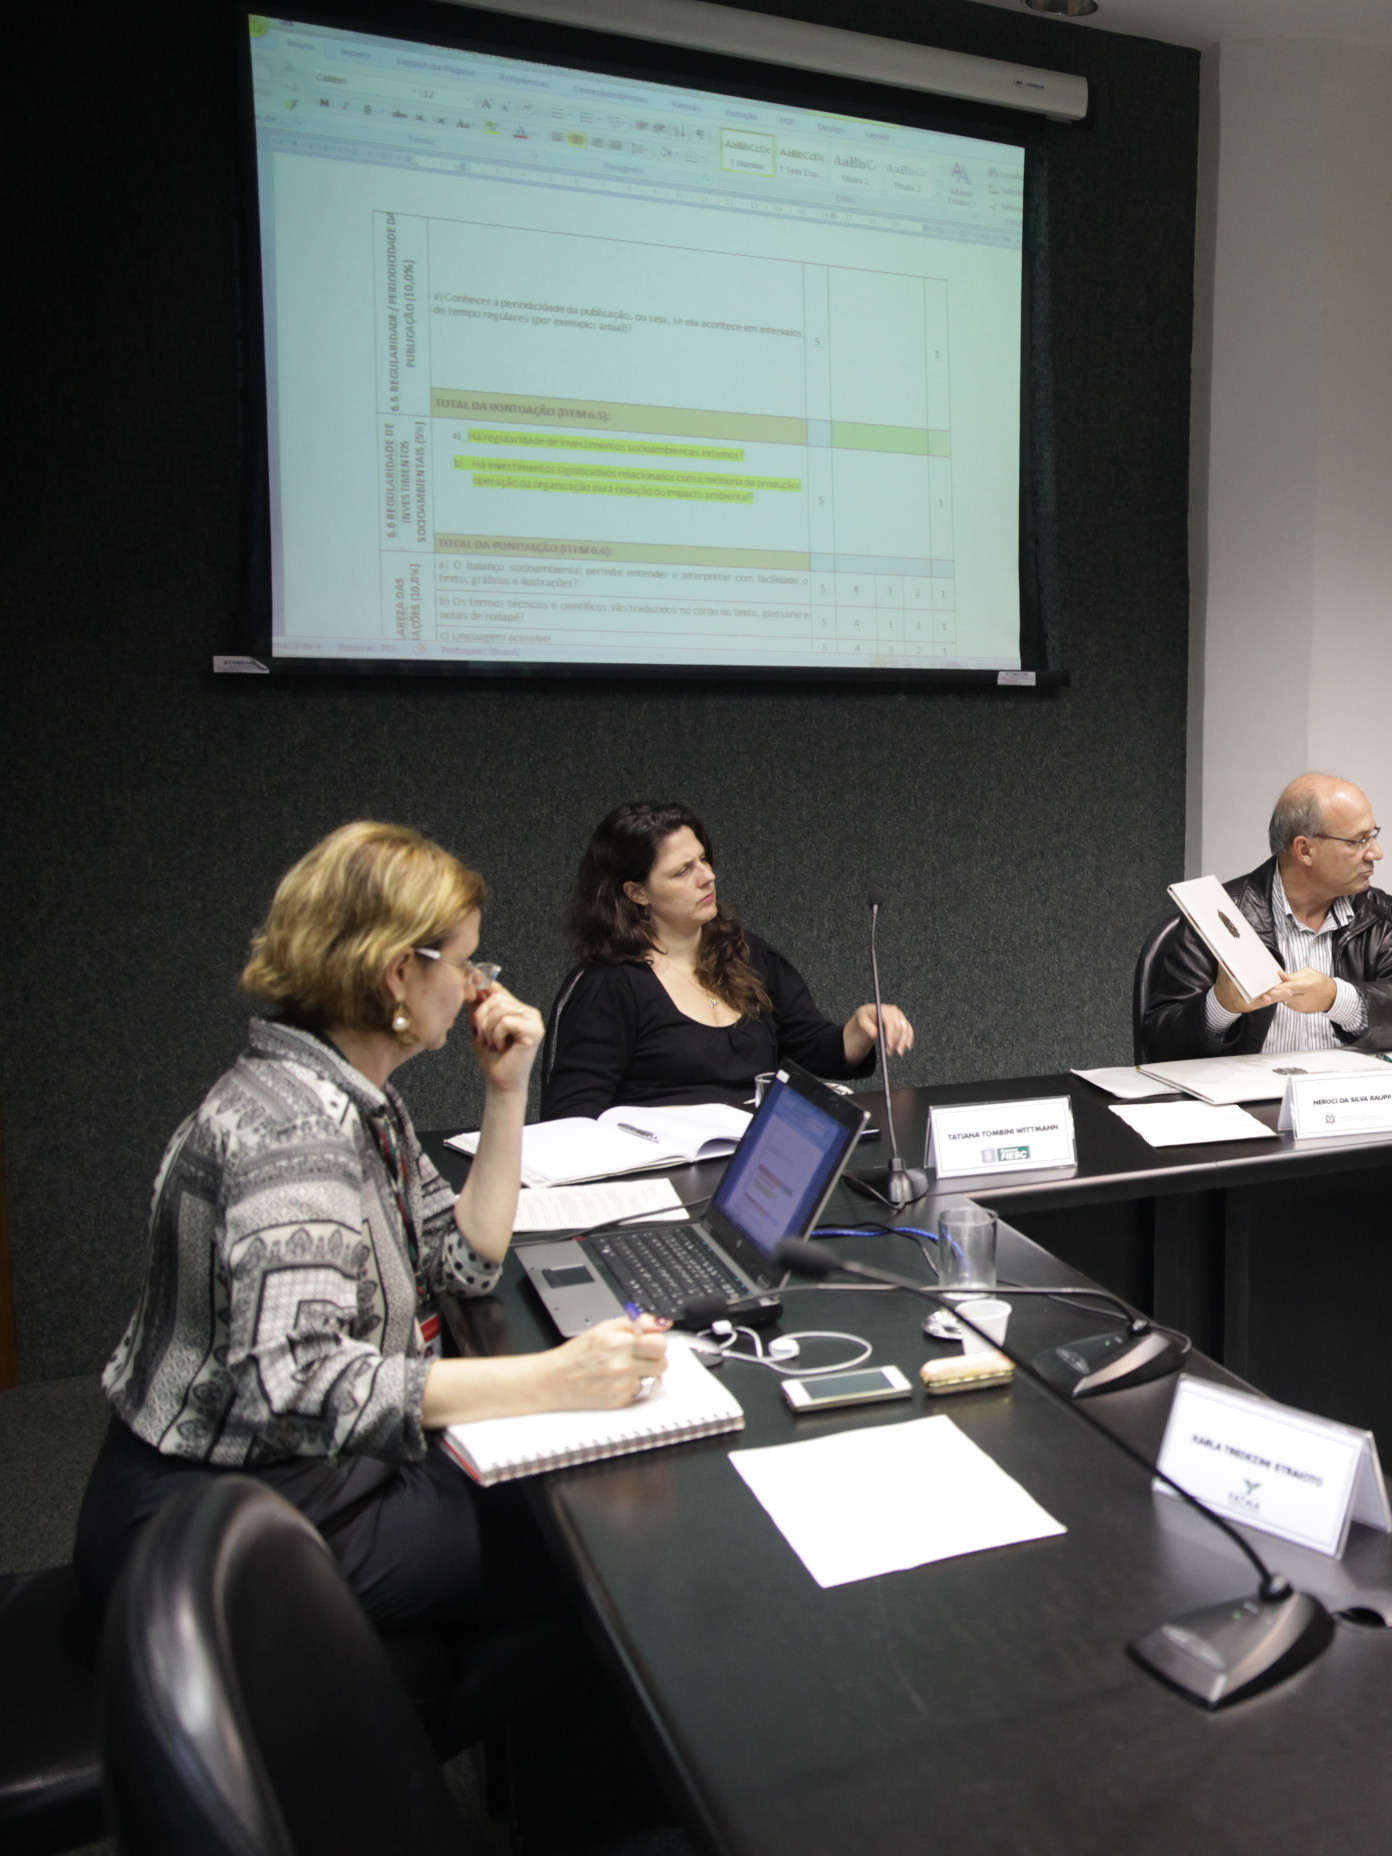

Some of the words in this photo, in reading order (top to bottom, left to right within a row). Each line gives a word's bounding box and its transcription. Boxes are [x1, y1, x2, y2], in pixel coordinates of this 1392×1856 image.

[387, 226, 398, 305] PERIODICIDADE
[403, 259, 416, 302] (10,0%)
[445, 292, 492, 306] Conhecer
[500, 299, 565, 313] periodicidade
[701, 320, 742, 331] acontece
[760, 326, 801, 338] intervalos
[448, 307, 480, 319] tempo
[482, 310, 529, 324] regulares
[531, 315, 551, 327] (por
[403, 304, 417, 368] PUBLICAÇÃO
[388, 314, 400, 392] REGULARIDADE
[435, 398, 469, 410] TOTAL
[488, 403, 555, 419] PONTUAÇÃO
[557, 408, 587, 420] (ITEM
[384, 423, 394, 437] DE
[483, 433, 545, 447] regularidade
[559, 438, 625, 452] investimentos
[628, 444, 700, 457] socioambientais
[385, 440, 396, 520] REGULARIDADE
[400, 441, 411, 524] INVESTIMENTOS
[487, 461, 555, 474] investimentos
[557, 465, 618, 479] significativos
[619, 470, 675, 481] relacionados
[677, 474, 696, 483] com
[415, 446, 427, 543] SOCIOAMBIENTAIS
[472, 477, 518, 490] operação
[533, 481, 591, 494] organização
[592, 484, 613, 495] para
[615, 484, 652, 497] redução
[666, 488, 701, 500] impacto
[439, 538, 472, 549] TOTAL
[492, 541, 557, 554] PONTUAÇÃO
[560, 544, 591, 556] (ITEM
[439, 573, 468, 585] texto,
[471, 575, 510, 587] gráficos
[510, 563, 582, 575] socioambiental
[586, 566, 623, 578] permite
[626, 568, 668, 579] entender
[682, 571, 731, 584] interpretar
[735, 575, 754, 583] com
[757, 574, 799, 585] facilidade
[394, 577, 405, 599] DAS
[439, 611, 468, 620] notas
[484, 612, 524, 623] rodapé?
[469, 599, 505, 608] termos
[610, 602, 627, 612] são
[629, 604, 677, 615] traduzidos
[693, 609, 718, 618] corpo
[395, 602, 406, 640] AREZA
[410, 604, 421, 640] AÇÕES
[1313, 1098, 1338, 1106] NEROCI
[948, 1131, 980, 1141] TATIANA
[981, 1128, 1015, 1137] TOMBINI
[1016, 1124, 1059, 1135] WITTMANN
